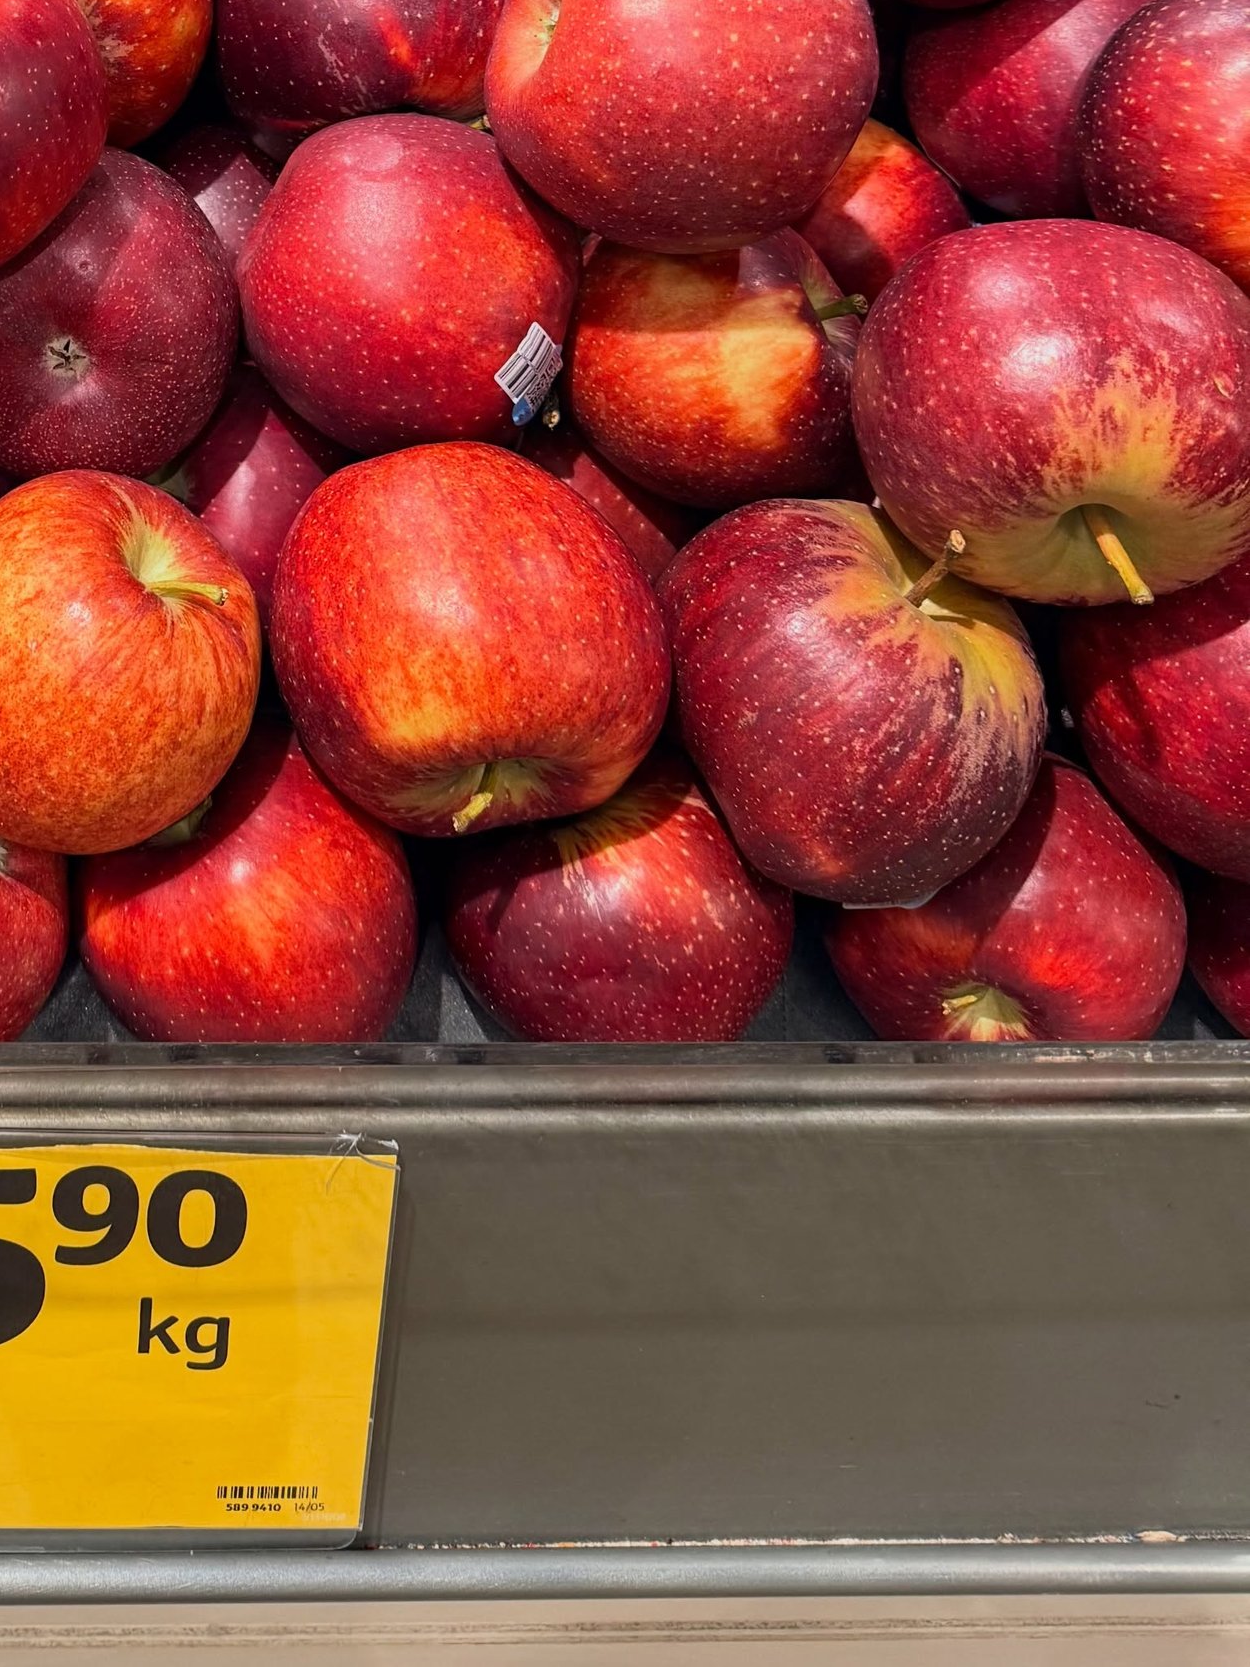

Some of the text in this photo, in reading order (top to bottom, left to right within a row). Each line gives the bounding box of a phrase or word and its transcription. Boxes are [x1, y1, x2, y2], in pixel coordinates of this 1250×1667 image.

[137, 1296, 231, 1371] kg
[225, 1503, 249, 1512] 589
[251, 1503, 282, 1512] 9410
